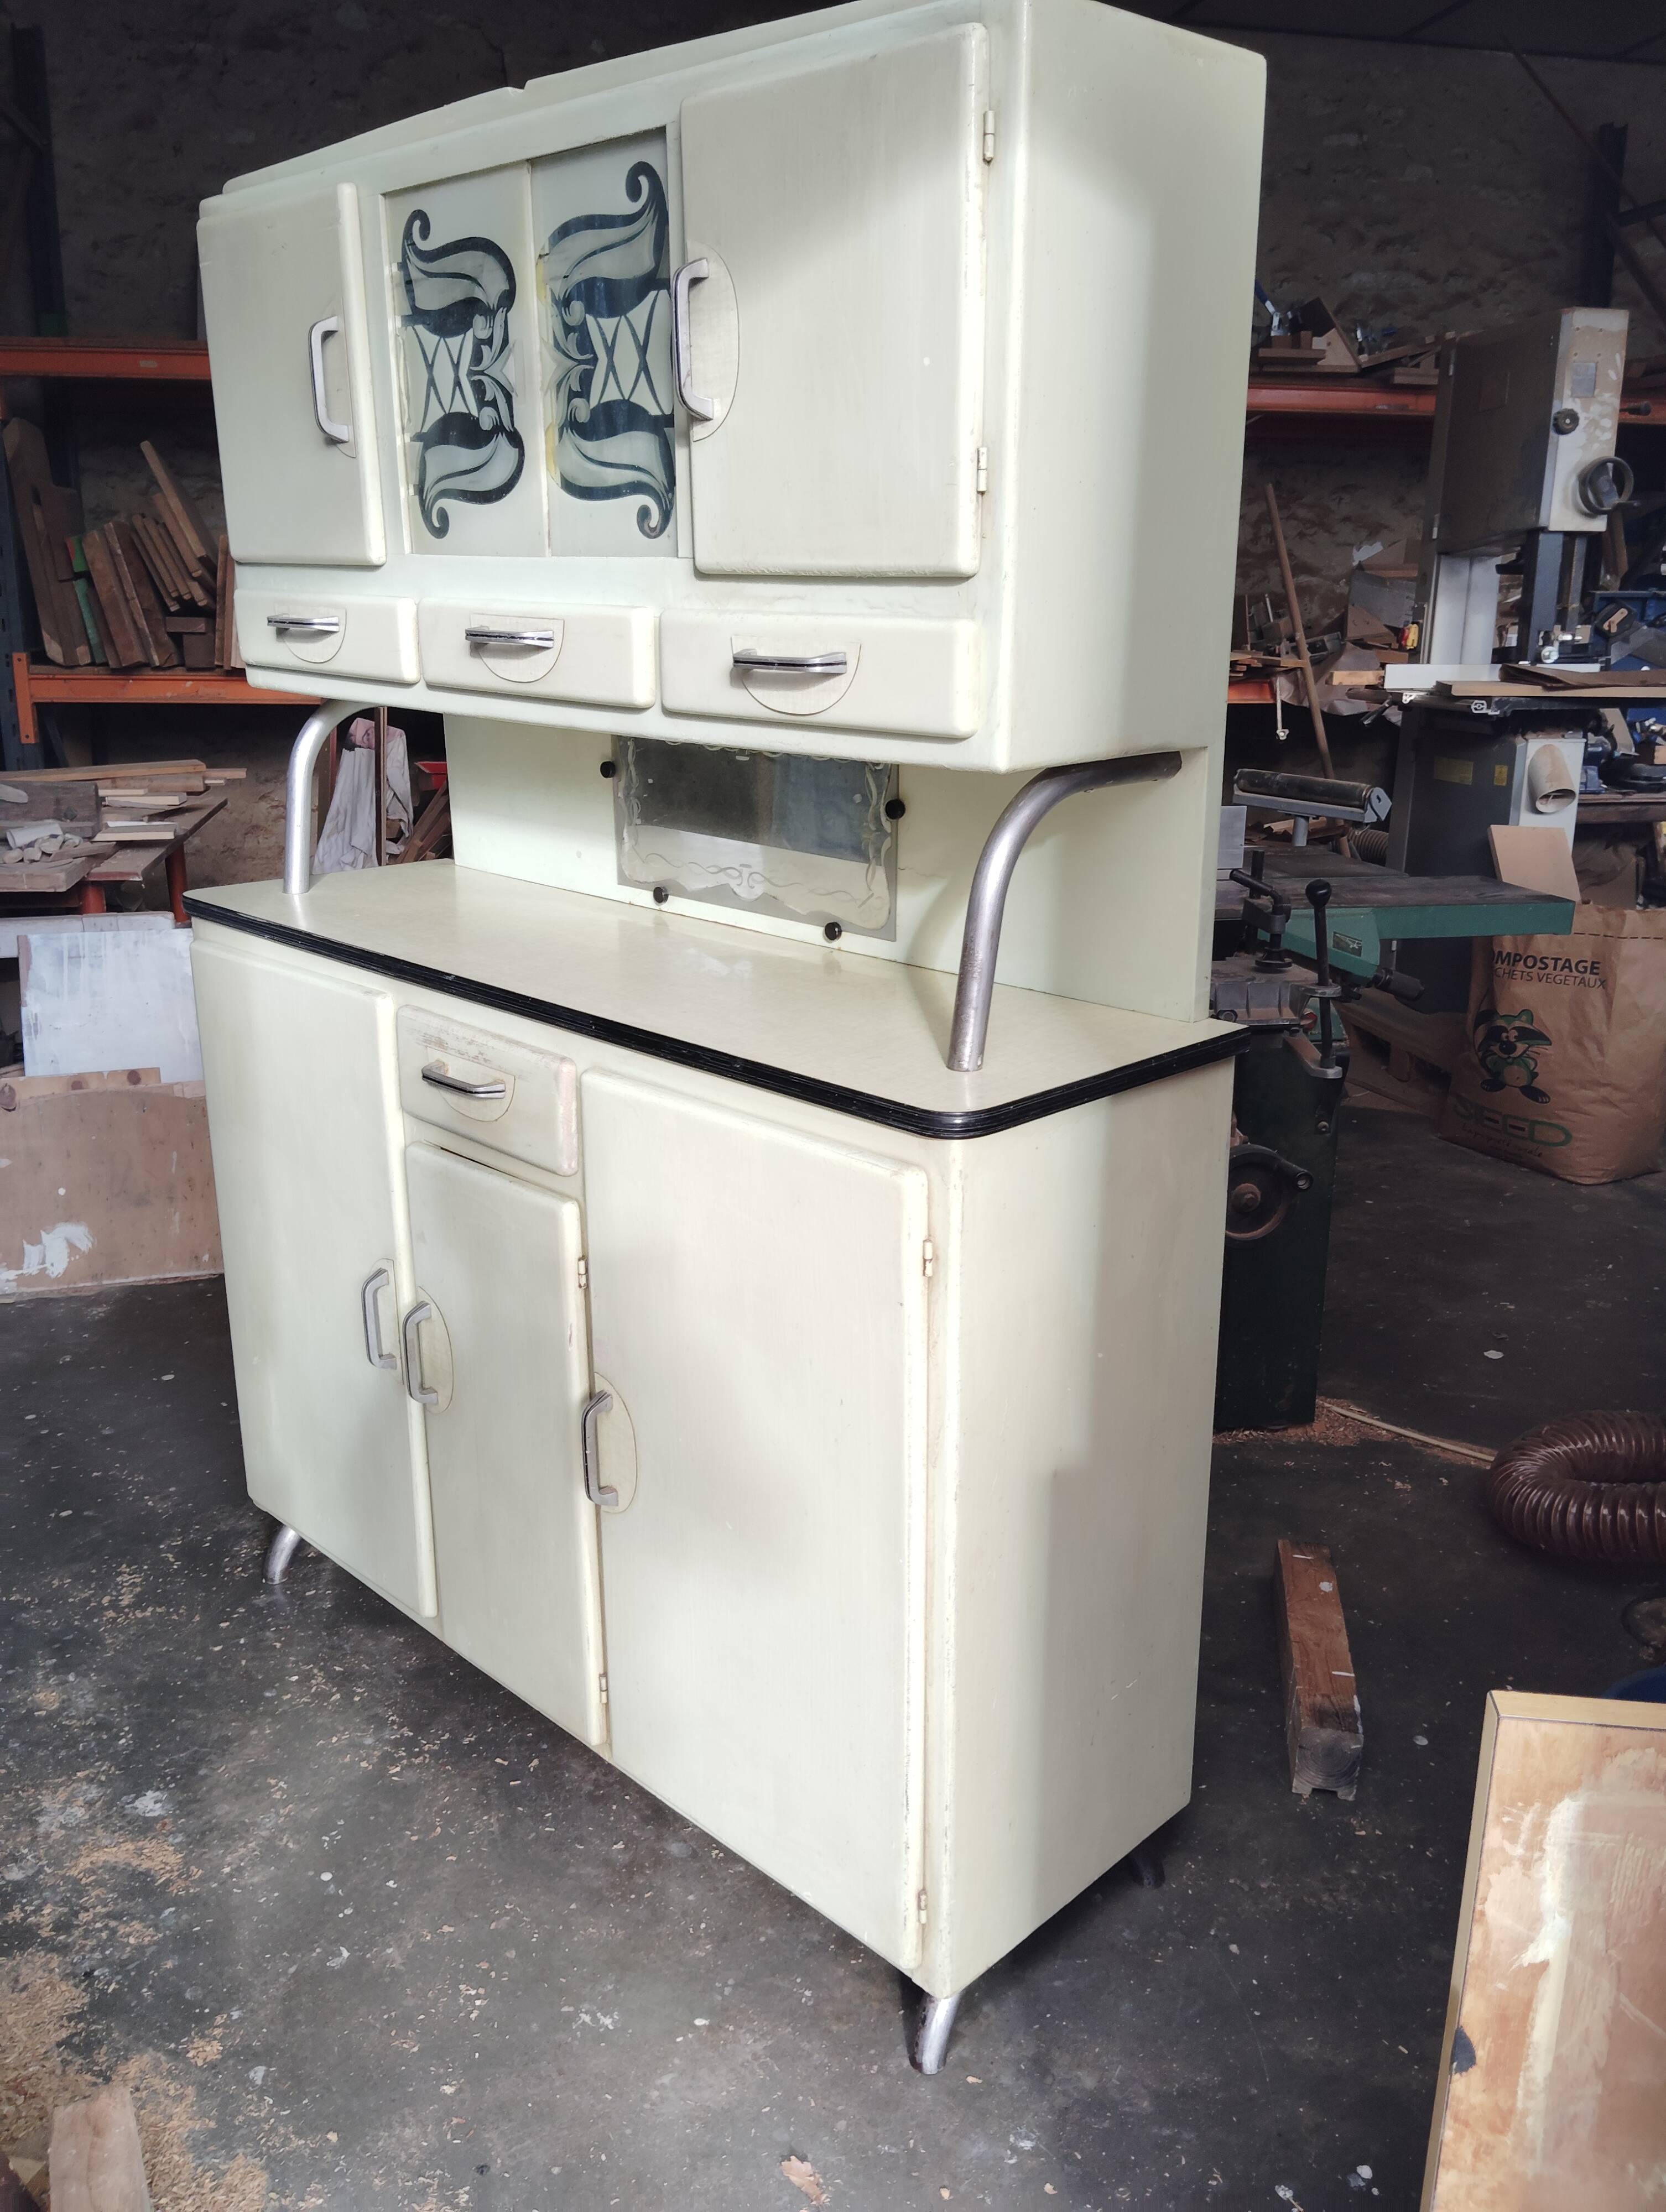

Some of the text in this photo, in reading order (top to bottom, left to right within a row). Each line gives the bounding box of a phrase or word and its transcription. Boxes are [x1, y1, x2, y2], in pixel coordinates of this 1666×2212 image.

[1492, 950, 1601, 976] MPOSTAGE
[1493, 967, 1607, 990] CHETS VEGETAUX
